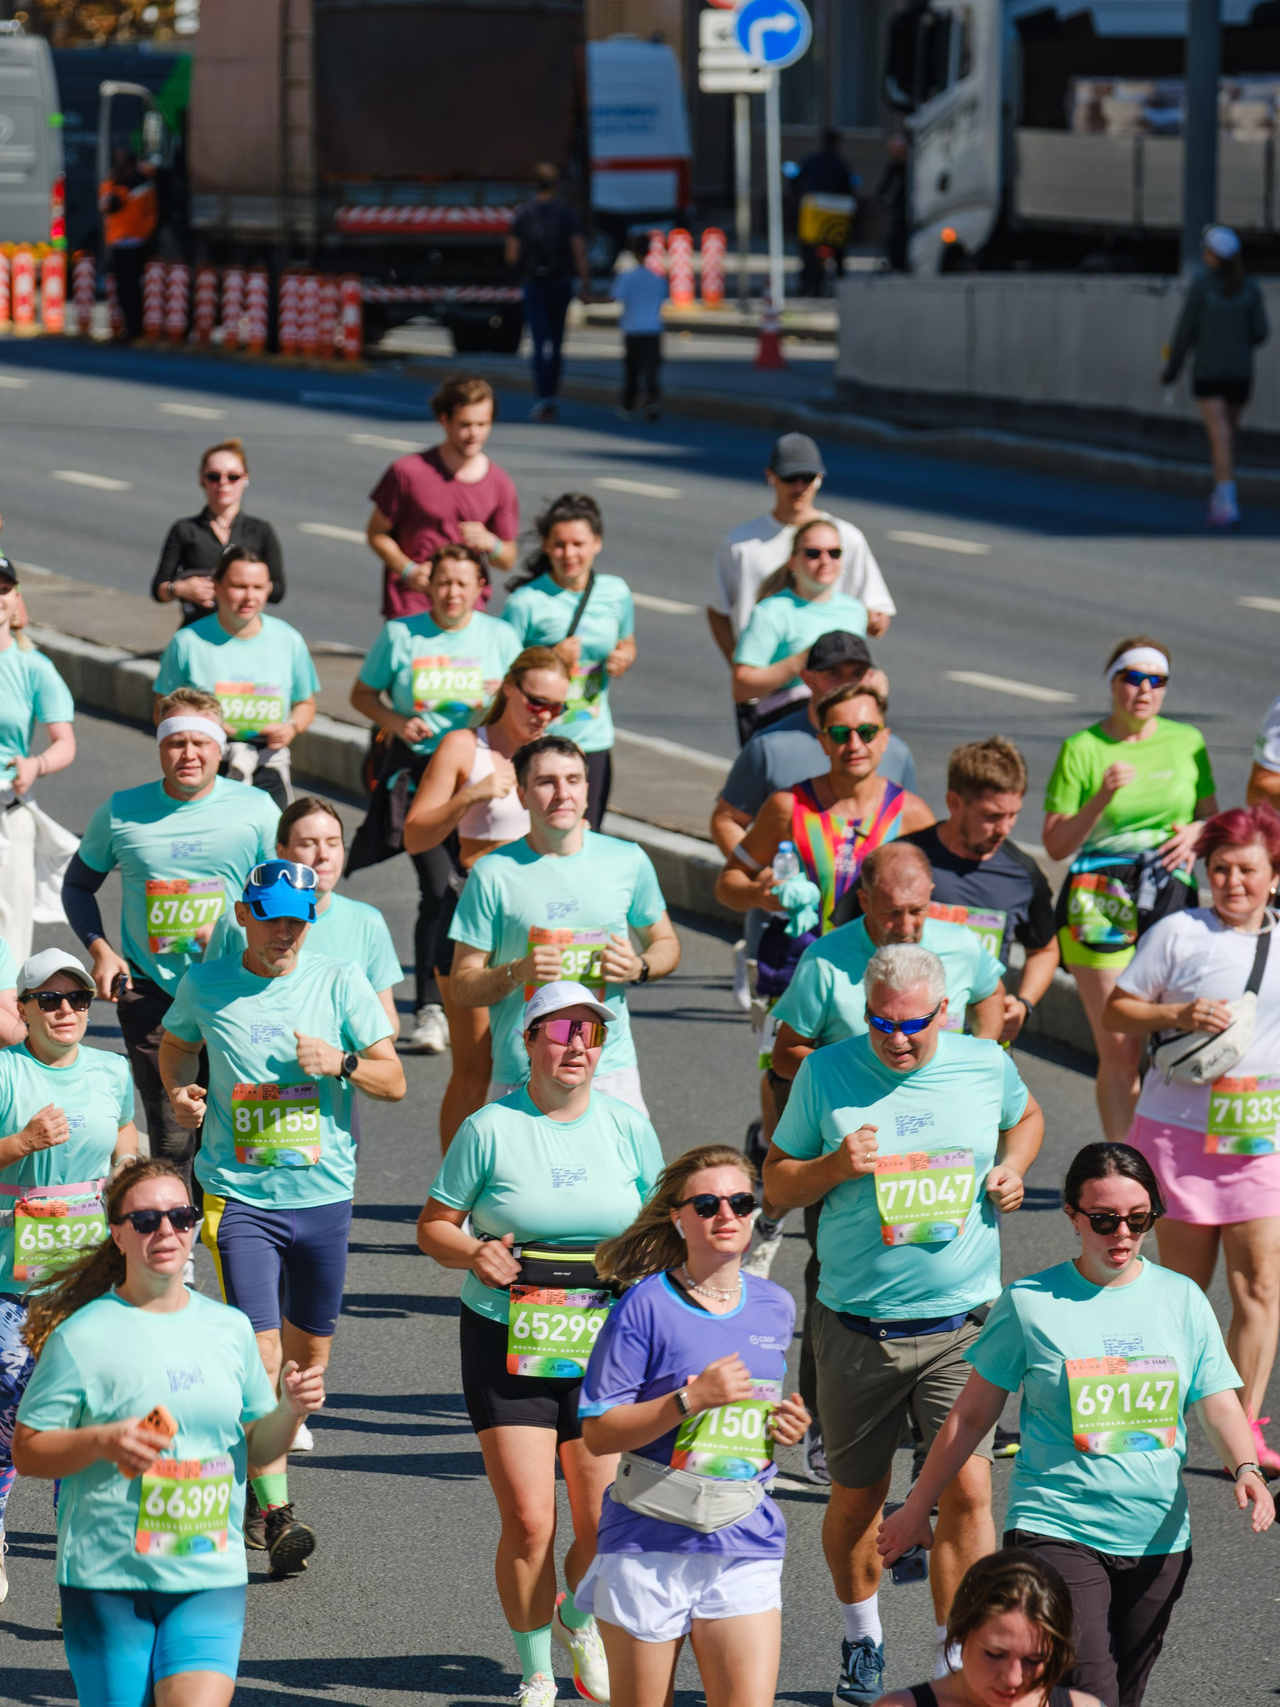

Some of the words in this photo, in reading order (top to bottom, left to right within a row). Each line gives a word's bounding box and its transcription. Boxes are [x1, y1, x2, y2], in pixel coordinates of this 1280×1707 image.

[150, 898, 223, 924] 67677
[235, 1105, 318, 1133] 81155
[880, 1174, 974, 1210] 77047
[20, 1221, 103, 1250] 65322
[513, 1311, 606, 1343] 65299
[1076, 1380, 1175, 1416] 69147
[145, 1482, 229, 1518] 66399
